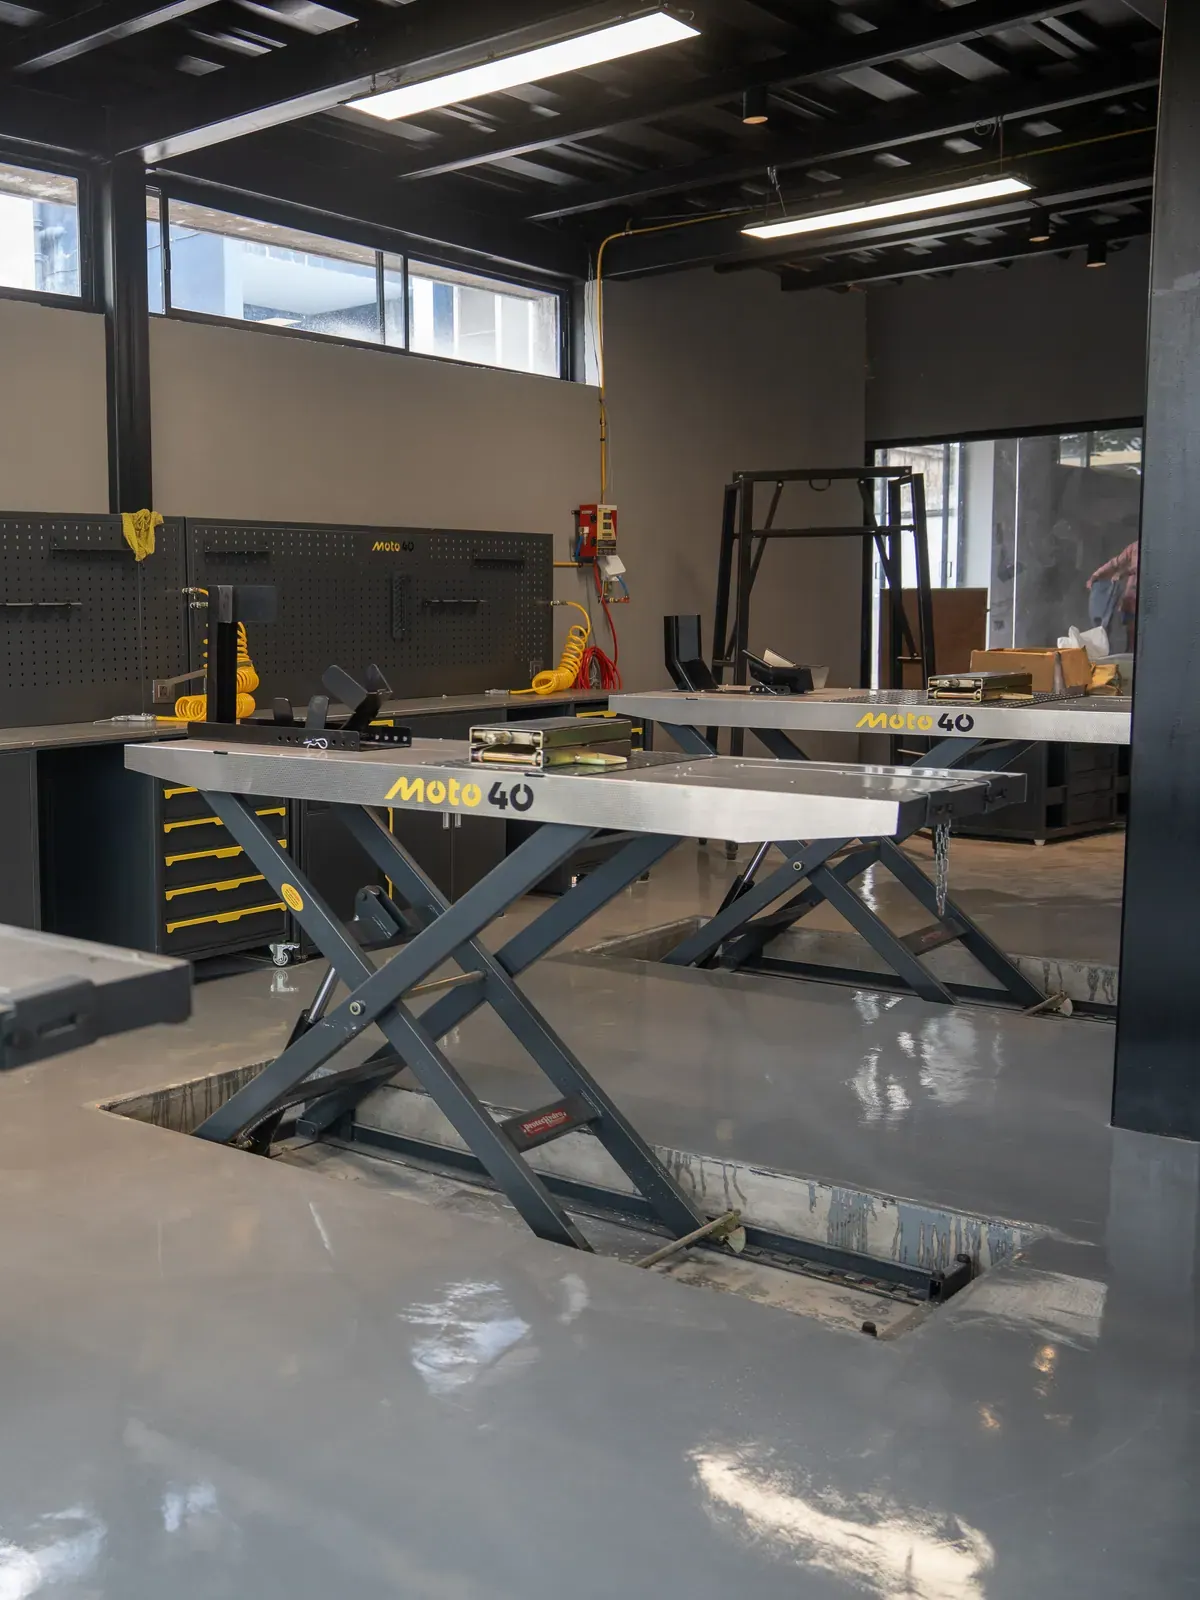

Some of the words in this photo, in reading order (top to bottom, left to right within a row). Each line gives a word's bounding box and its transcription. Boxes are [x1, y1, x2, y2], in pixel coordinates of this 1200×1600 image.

[371, 541, 400, 552] Moto
[855, 711, 933, 730] Moto
[937, 713, 974, 732] 40
[384, 776, 482, 807] Moto
[487, 781, 534, 812] 40
